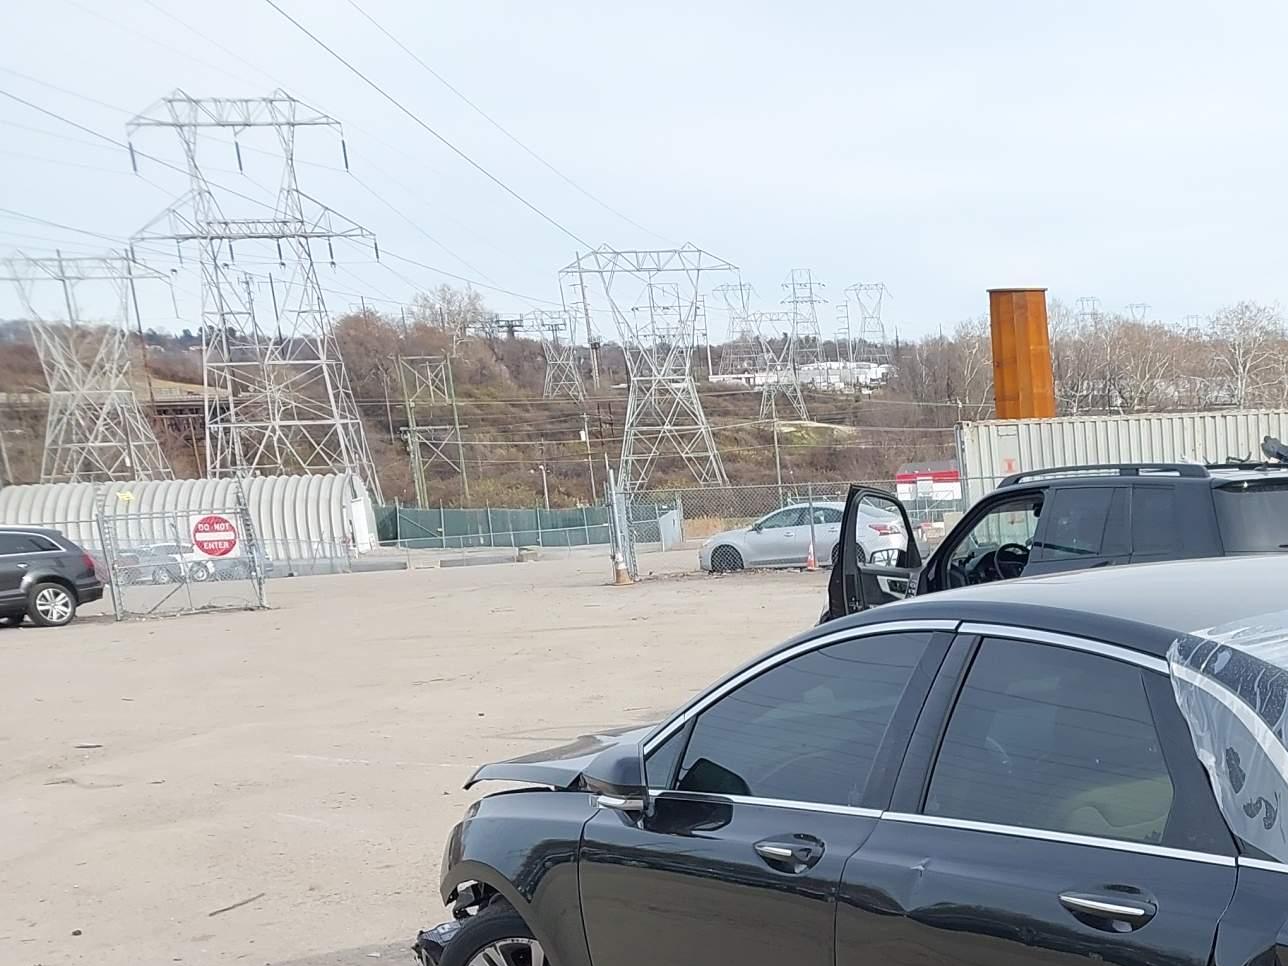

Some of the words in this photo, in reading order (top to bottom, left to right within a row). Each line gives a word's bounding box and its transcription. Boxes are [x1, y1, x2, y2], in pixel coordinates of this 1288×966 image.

[198, 523, 210, 531] DO
[214, 522, 229, 531] NOT
[203, 541, 229, 550] ENTER
